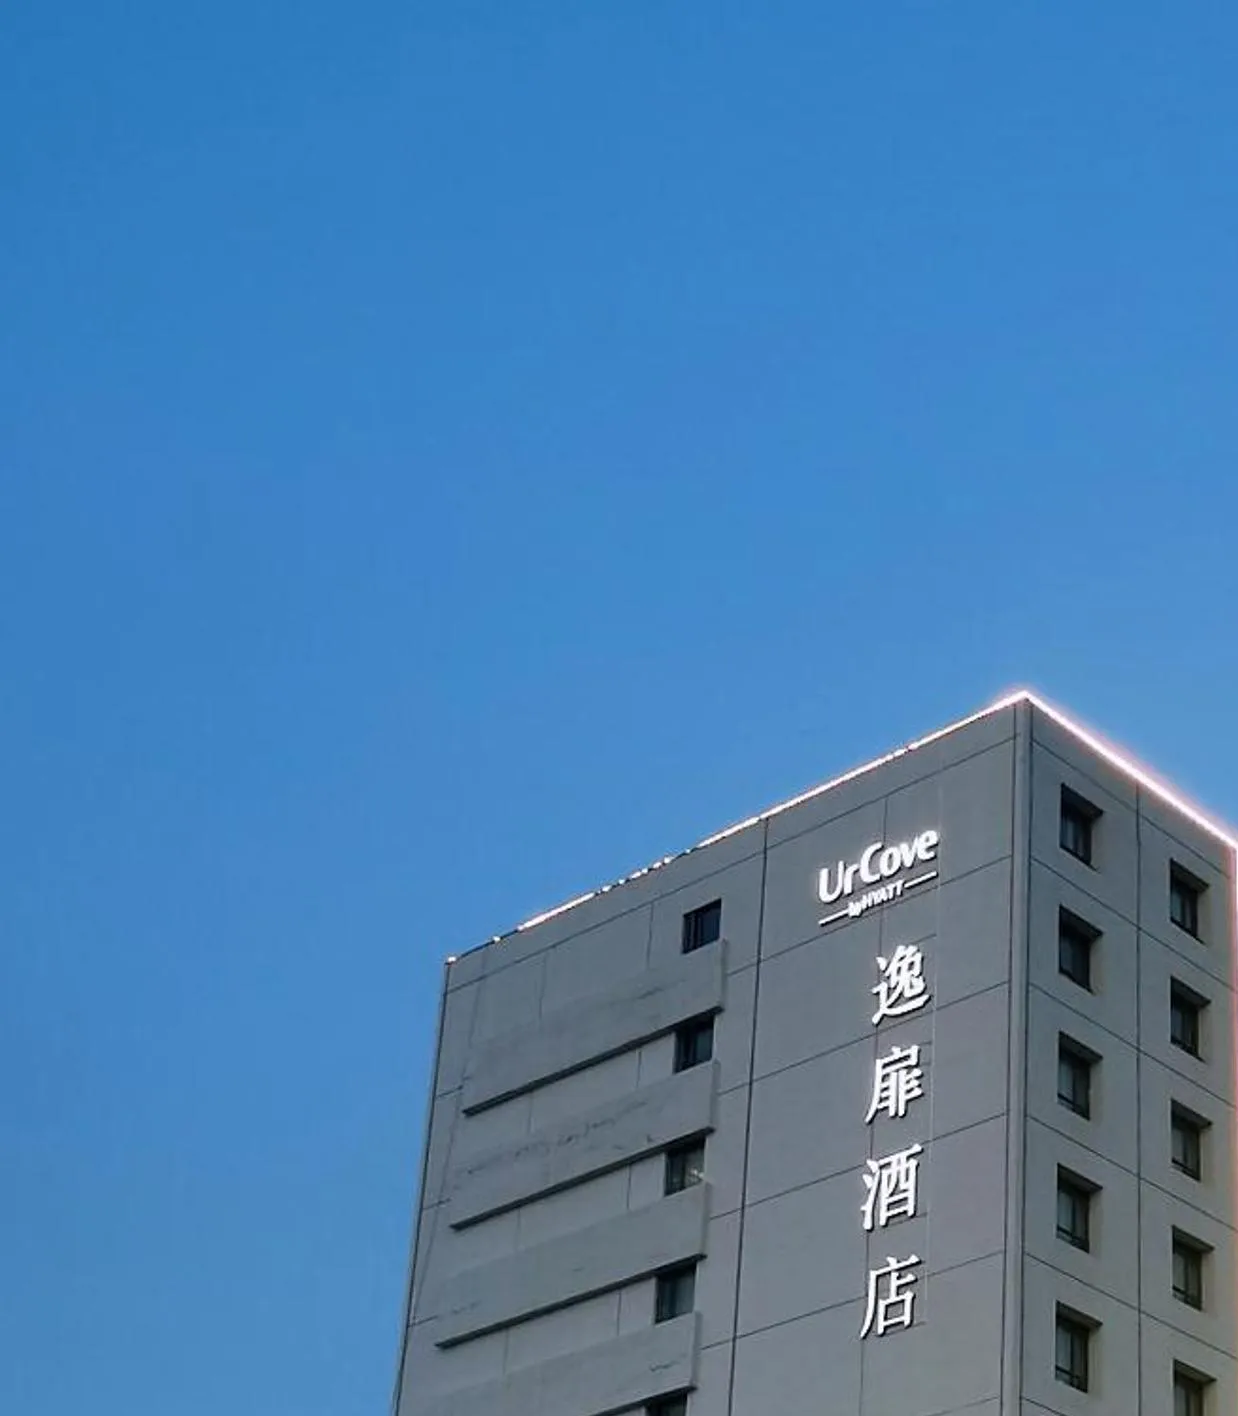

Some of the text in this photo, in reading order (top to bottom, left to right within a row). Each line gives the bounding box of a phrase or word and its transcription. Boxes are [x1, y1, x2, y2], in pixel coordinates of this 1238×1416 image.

[818, 829, 939, 903] UrCove
[861, 880, 905, 911] HYATT
[859, 943, 931, 1340] 逸扉酒店
